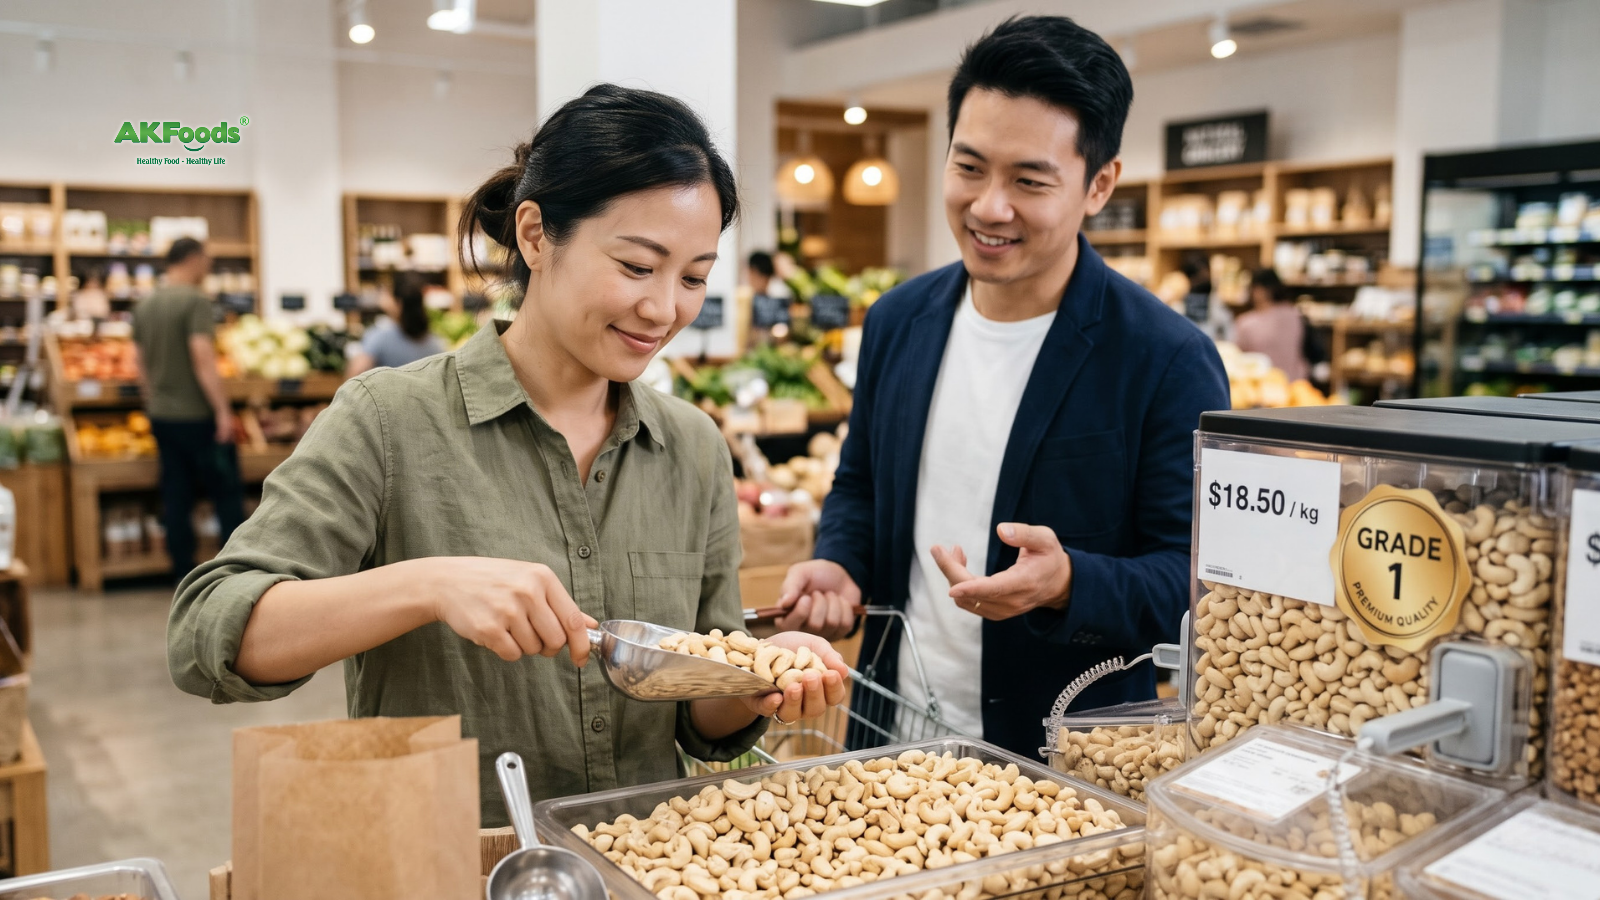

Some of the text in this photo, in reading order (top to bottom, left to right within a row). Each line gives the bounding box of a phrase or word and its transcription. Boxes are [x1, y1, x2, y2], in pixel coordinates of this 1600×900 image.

[1208, 479, 1285, 516] $18.50
[1300, 502, 1319, 525] kg
[1357, 527, 1442, 562] GRADE
[1388, 562, 1403, 600] 1
[1352, 581, 1439, 627] PREMIUM QUALITY
